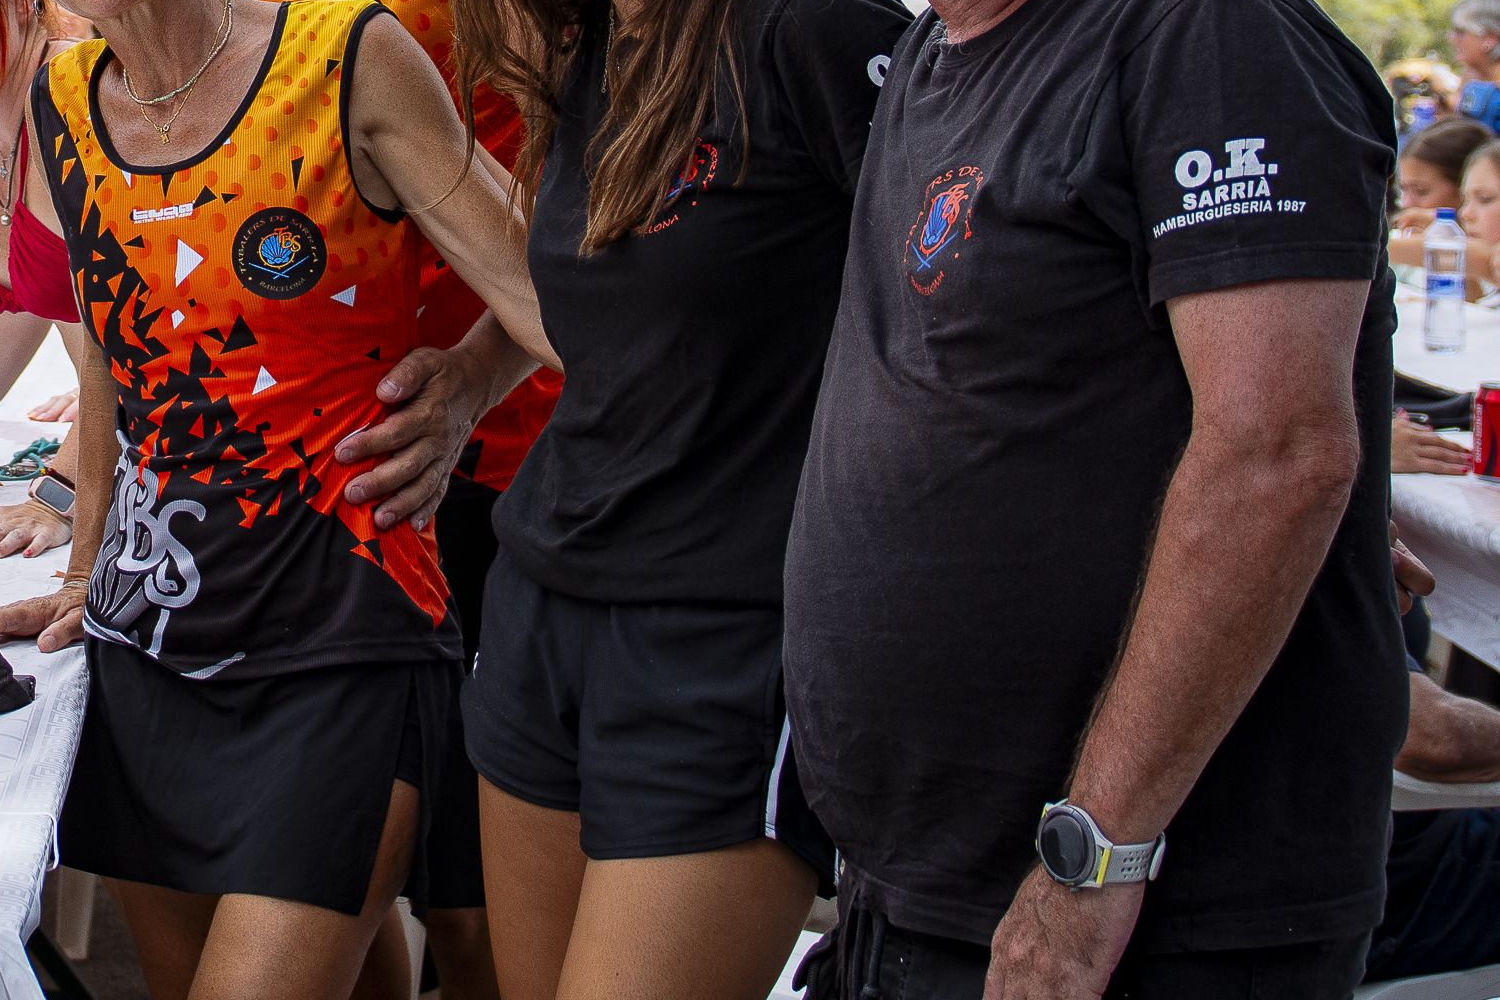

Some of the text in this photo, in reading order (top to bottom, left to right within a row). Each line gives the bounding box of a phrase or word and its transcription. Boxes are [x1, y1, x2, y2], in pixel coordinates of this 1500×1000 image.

[1175, 138, 1278, 188] O.K.
[1183, 177, 1271, 210] SARRIÀ
[1153, 199, 1307, 239] HAMBURGUESERIA 1987
[274, 225, 301, 253] TBS
